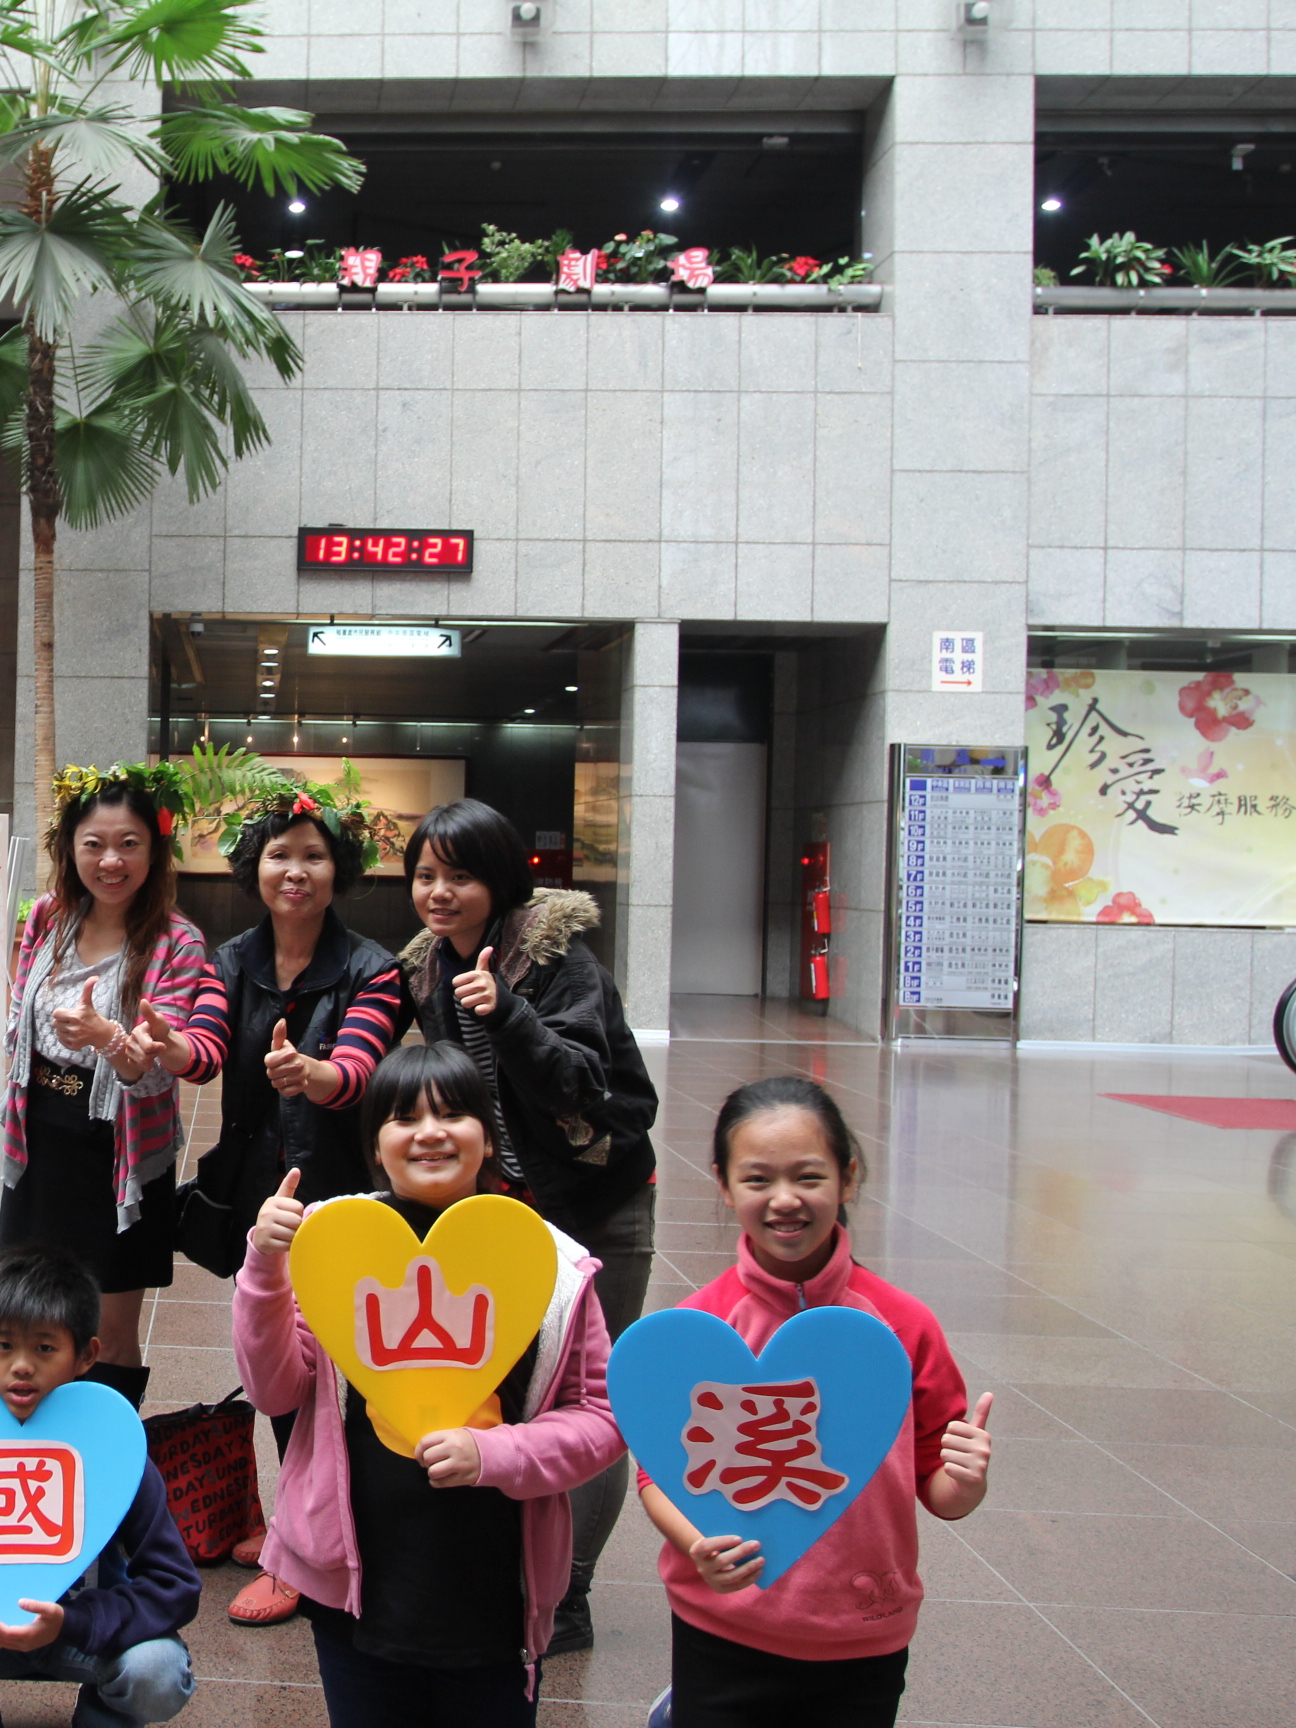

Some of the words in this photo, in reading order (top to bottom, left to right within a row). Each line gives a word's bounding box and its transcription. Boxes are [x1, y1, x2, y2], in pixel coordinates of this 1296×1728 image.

[339, 246, 715, 292] 親子劇場
[316, 535, 466, 565] 13:42:27
[939, 637, 977, 654] 南區
[938, 657, 976, 675] 電梯
[1045, 697, 1179, 836] 珍愛
[1175, 791, 1296, 826] 按摩服務
[908, 841, 924, 851] 9F
[908, 856, 924, 866] 8F
[908, 871, 923, 881] 7F
[907, 887, 923, 896] 6F
[907, 902, 922, 911] 5F
[906, 917, 922, 927] 4F
[906, 932, 922, 942] 3F
[906, 947, 921, 957] 2F
[905, 962, 921, 972] 1F
[365, 1264, 489, 1367] 山
[687, 1379, 850, 1509] 溪
